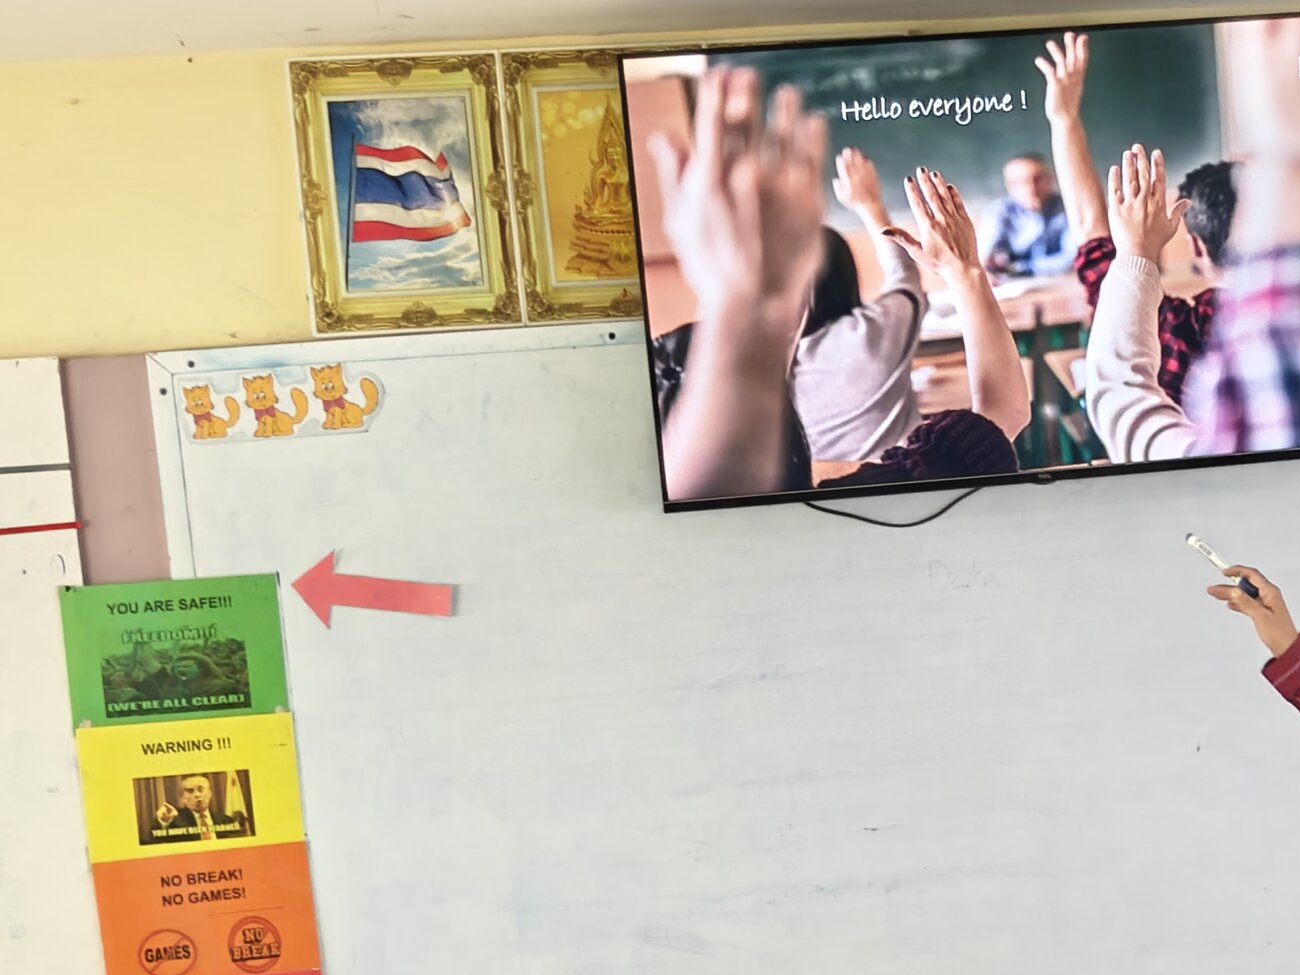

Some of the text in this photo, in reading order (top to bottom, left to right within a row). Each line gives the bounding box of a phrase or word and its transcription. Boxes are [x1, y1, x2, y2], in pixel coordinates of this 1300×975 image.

[841, 96, 902, 121] Hello
[908, 93, 1013, 125] everyone
[106, 596, 232, 616] YOU ARE SAFE!!!
[163, 697, 189, 708] ALL
[141, 738, 213, 756] WARNING
[161, 868, 243, 888] NO BREAK!
[162, 888, 246, 907] NO GAMES!
[243, 927, 264, 945] NO
[144, 944, 192, 964] GAMES
